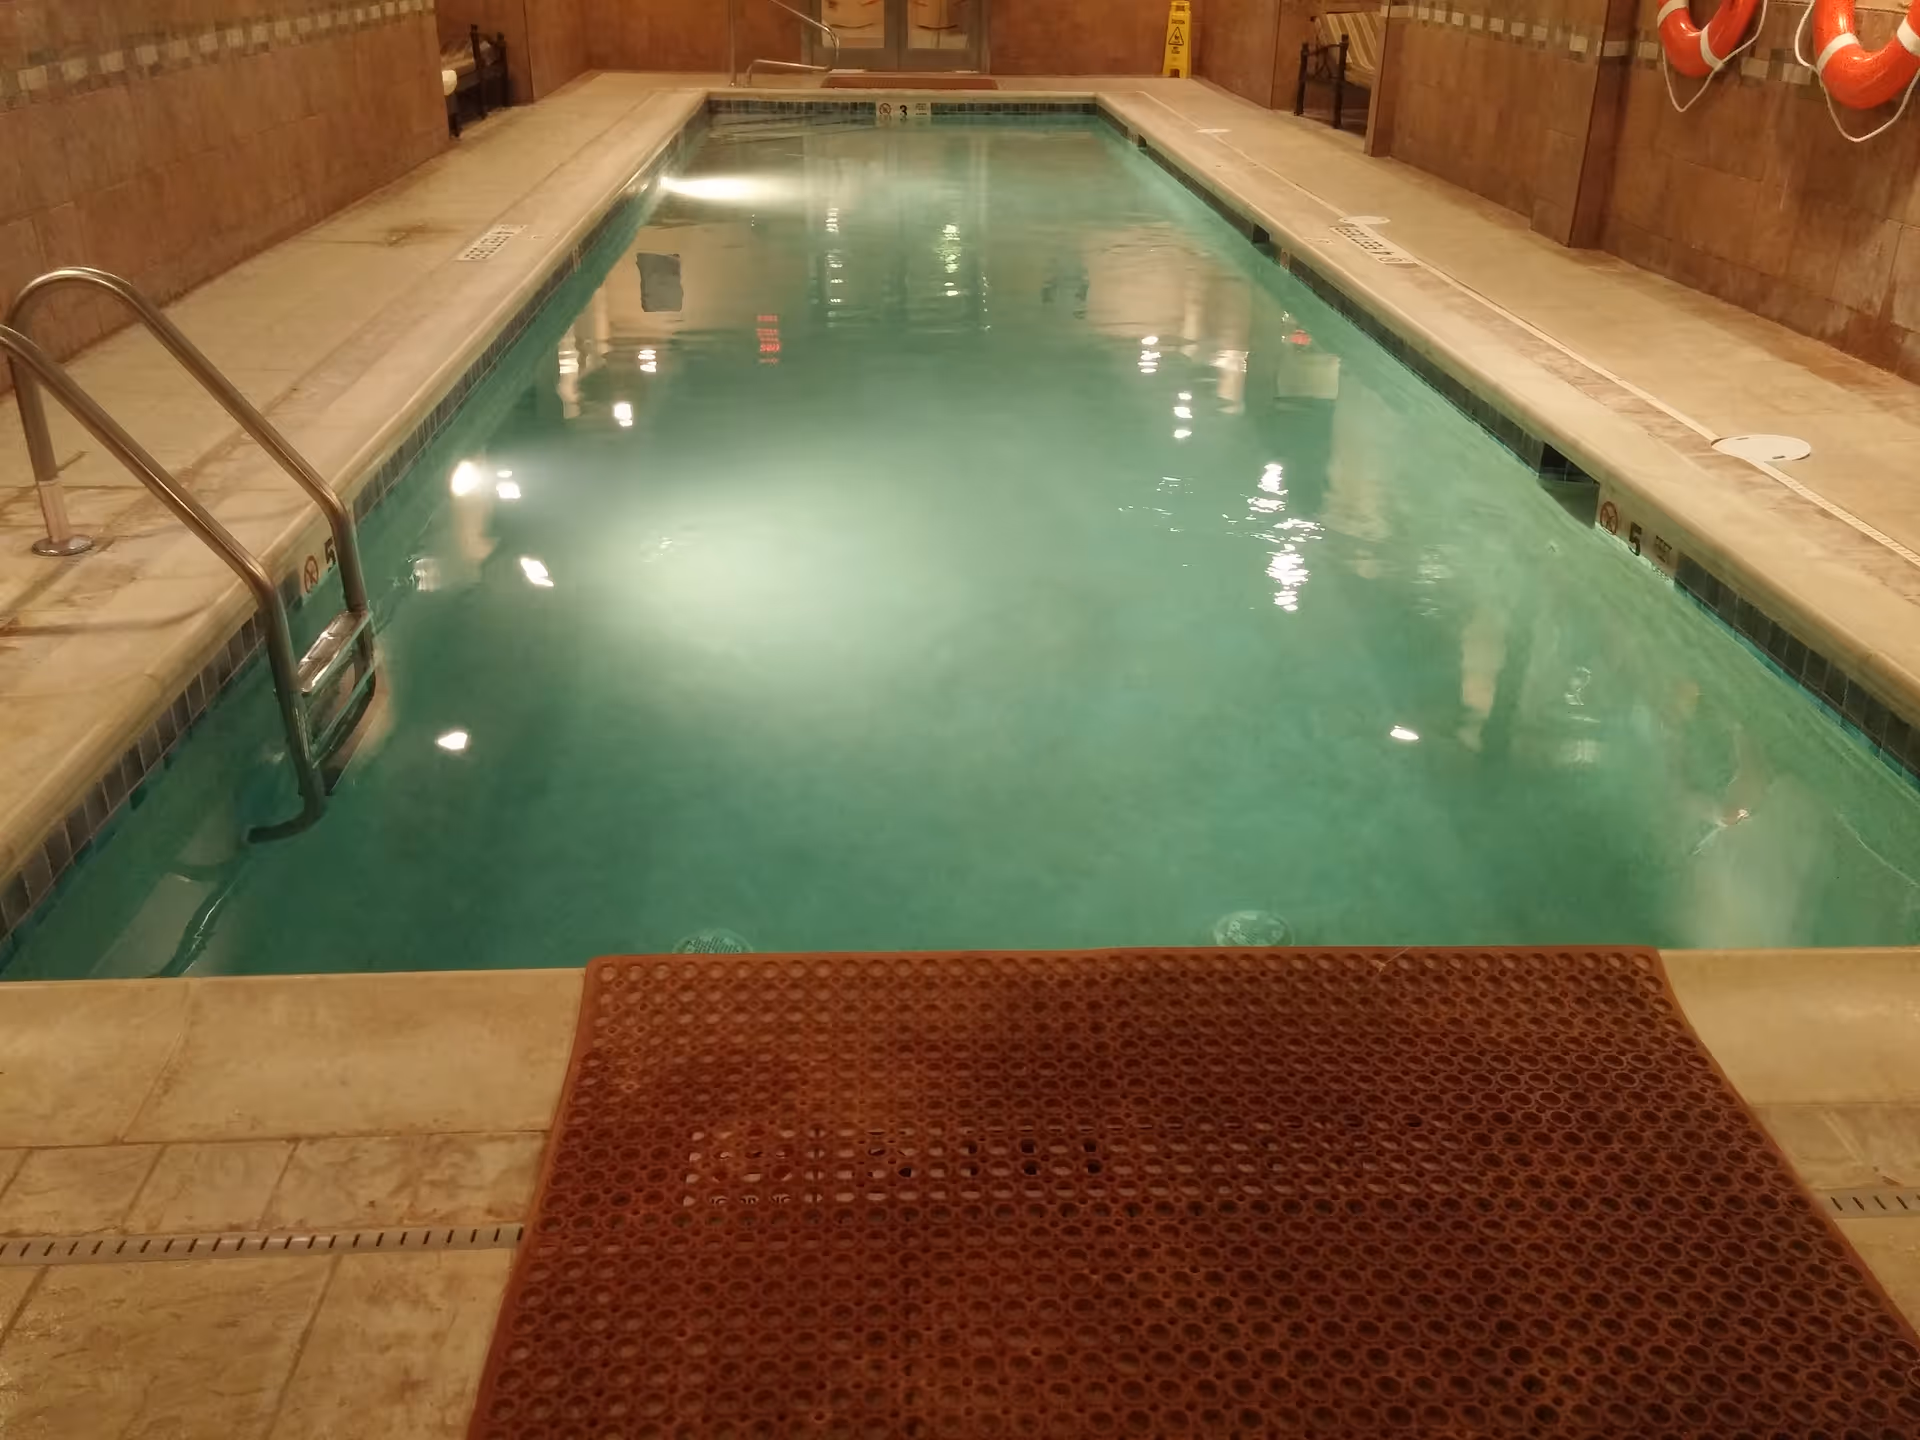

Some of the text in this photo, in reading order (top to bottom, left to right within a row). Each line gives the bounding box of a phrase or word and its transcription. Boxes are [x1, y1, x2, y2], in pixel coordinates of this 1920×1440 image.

[899, 104, 908, 117] 3
[324, 537, 336, 573] 5
[1628, 522, 1642, 556] 5
